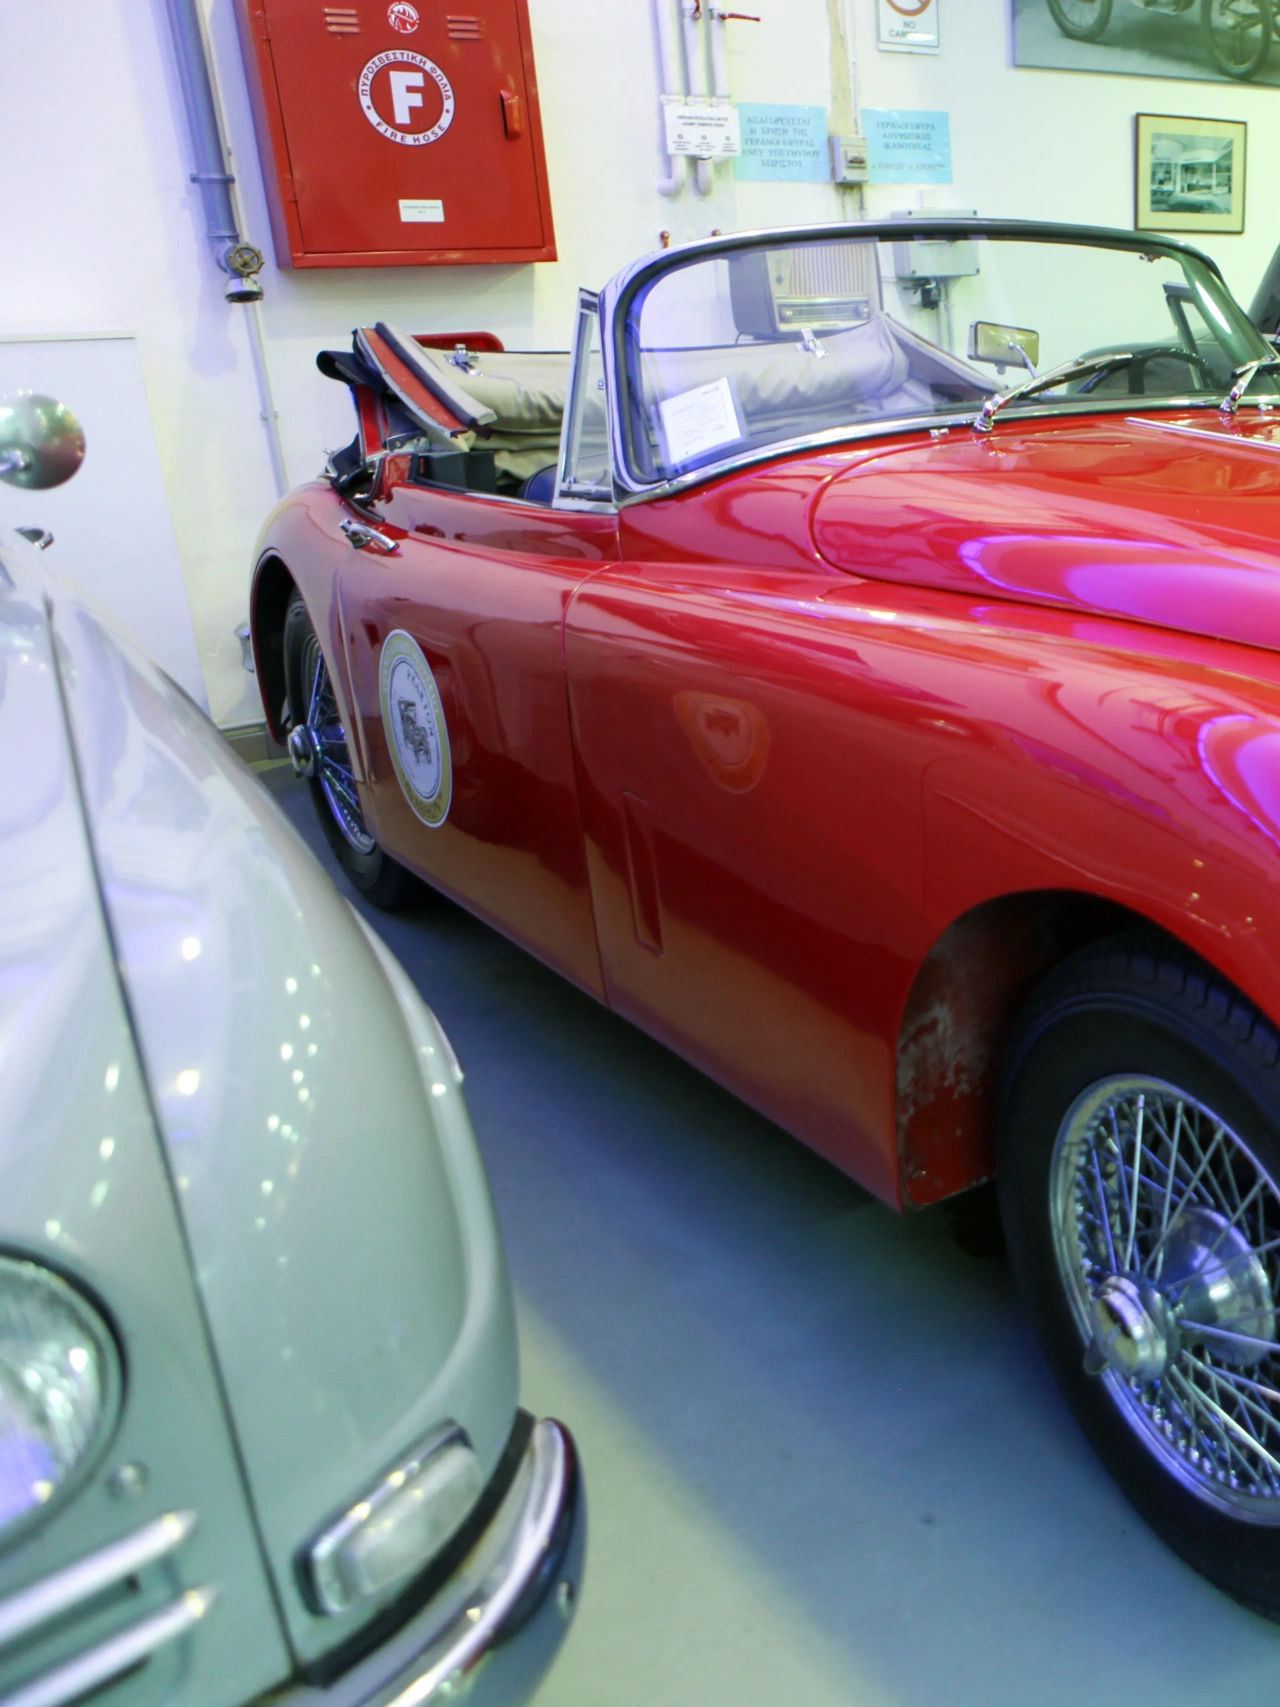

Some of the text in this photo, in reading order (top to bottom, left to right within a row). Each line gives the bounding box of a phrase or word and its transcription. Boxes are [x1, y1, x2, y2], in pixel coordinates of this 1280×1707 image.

[903, 20, 916, 29] NO
[361, 51, 452, 101] ΠΥΡΟΣΒΕΣΤΙΚΗ ΦΩΛΙΑ
[389, 70, 425, 125] F
[746, 116, 811, 126] ΑΠΑΓΟΡΕΥΕΤΑΙ
[376, 121, 446, 144] FIRE HOSE
[761, 127, 789, 136] ΧΡΗΣΗ
[792, 128, 809, 136] ΤΗΣ
